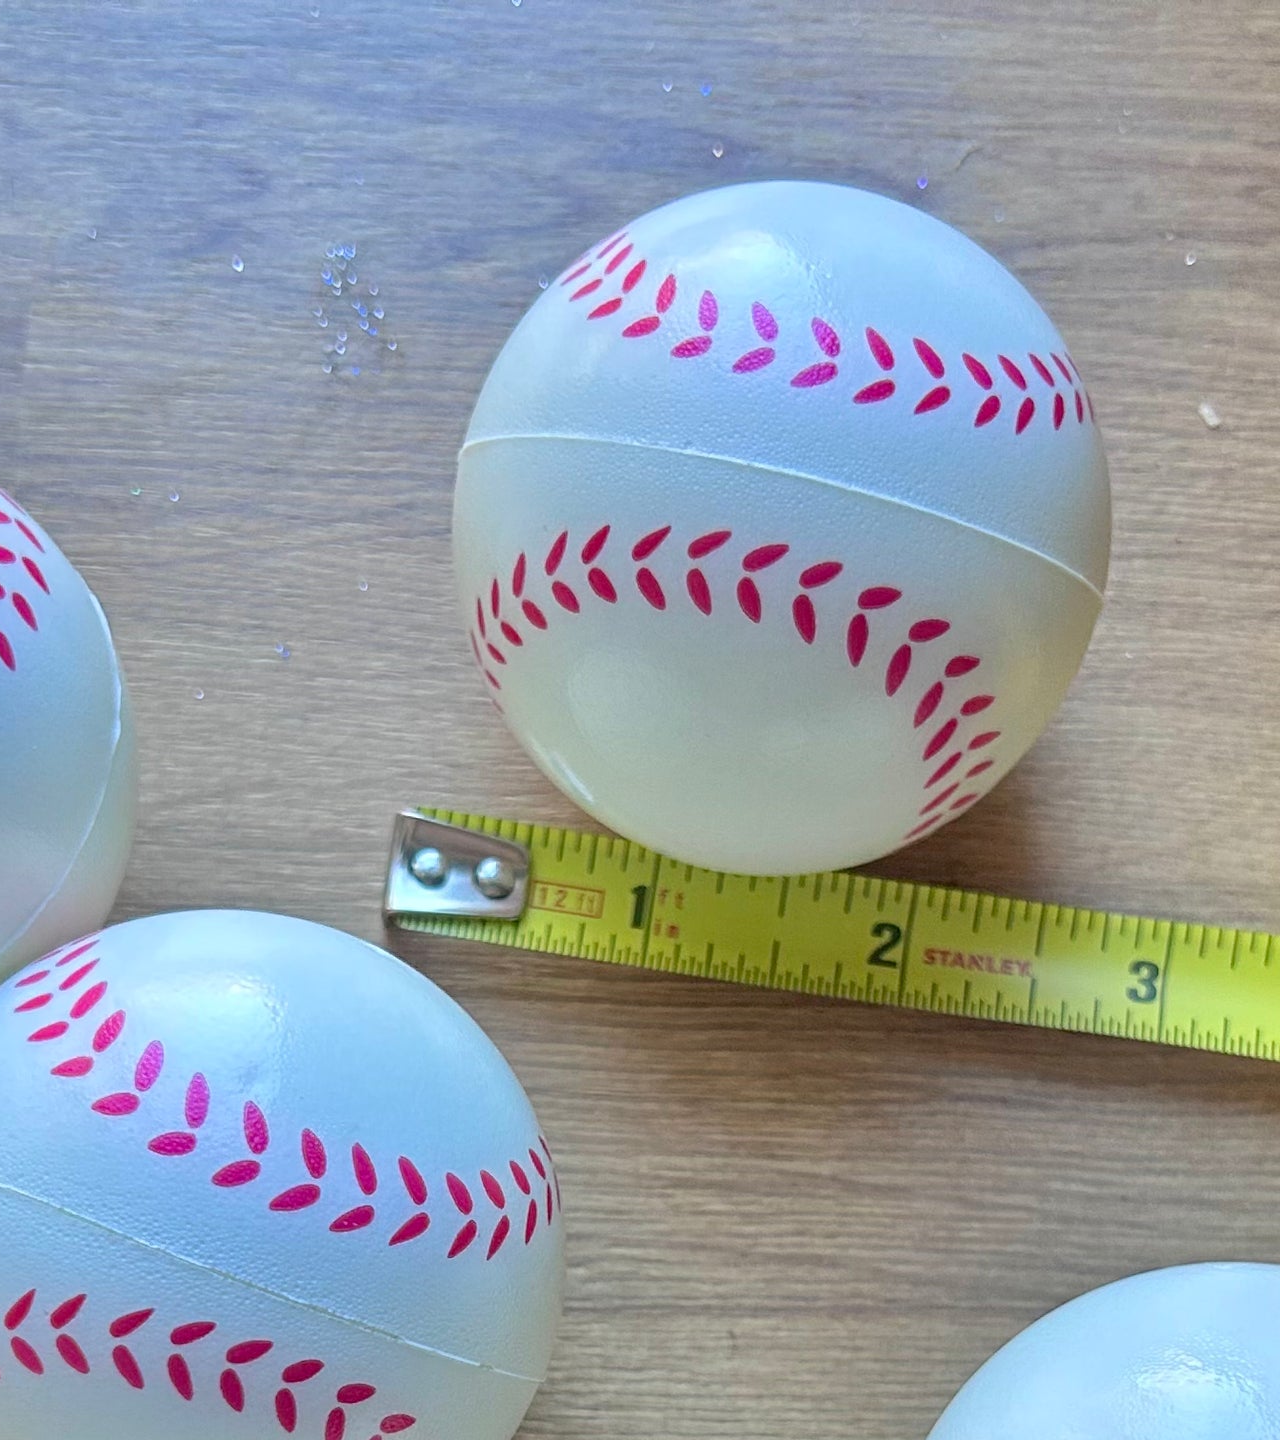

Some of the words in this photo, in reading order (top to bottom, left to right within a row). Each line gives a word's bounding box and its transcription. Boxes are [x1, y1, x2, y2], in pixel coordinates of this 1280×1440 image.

[537, 886, 567, 909] 12
[630, 885, 647, 929] 1
[867, 922, 902, 968] 2
[923, 947, 1032, 977] STANLEY
[1127, 961, 1160, 1003] 3
